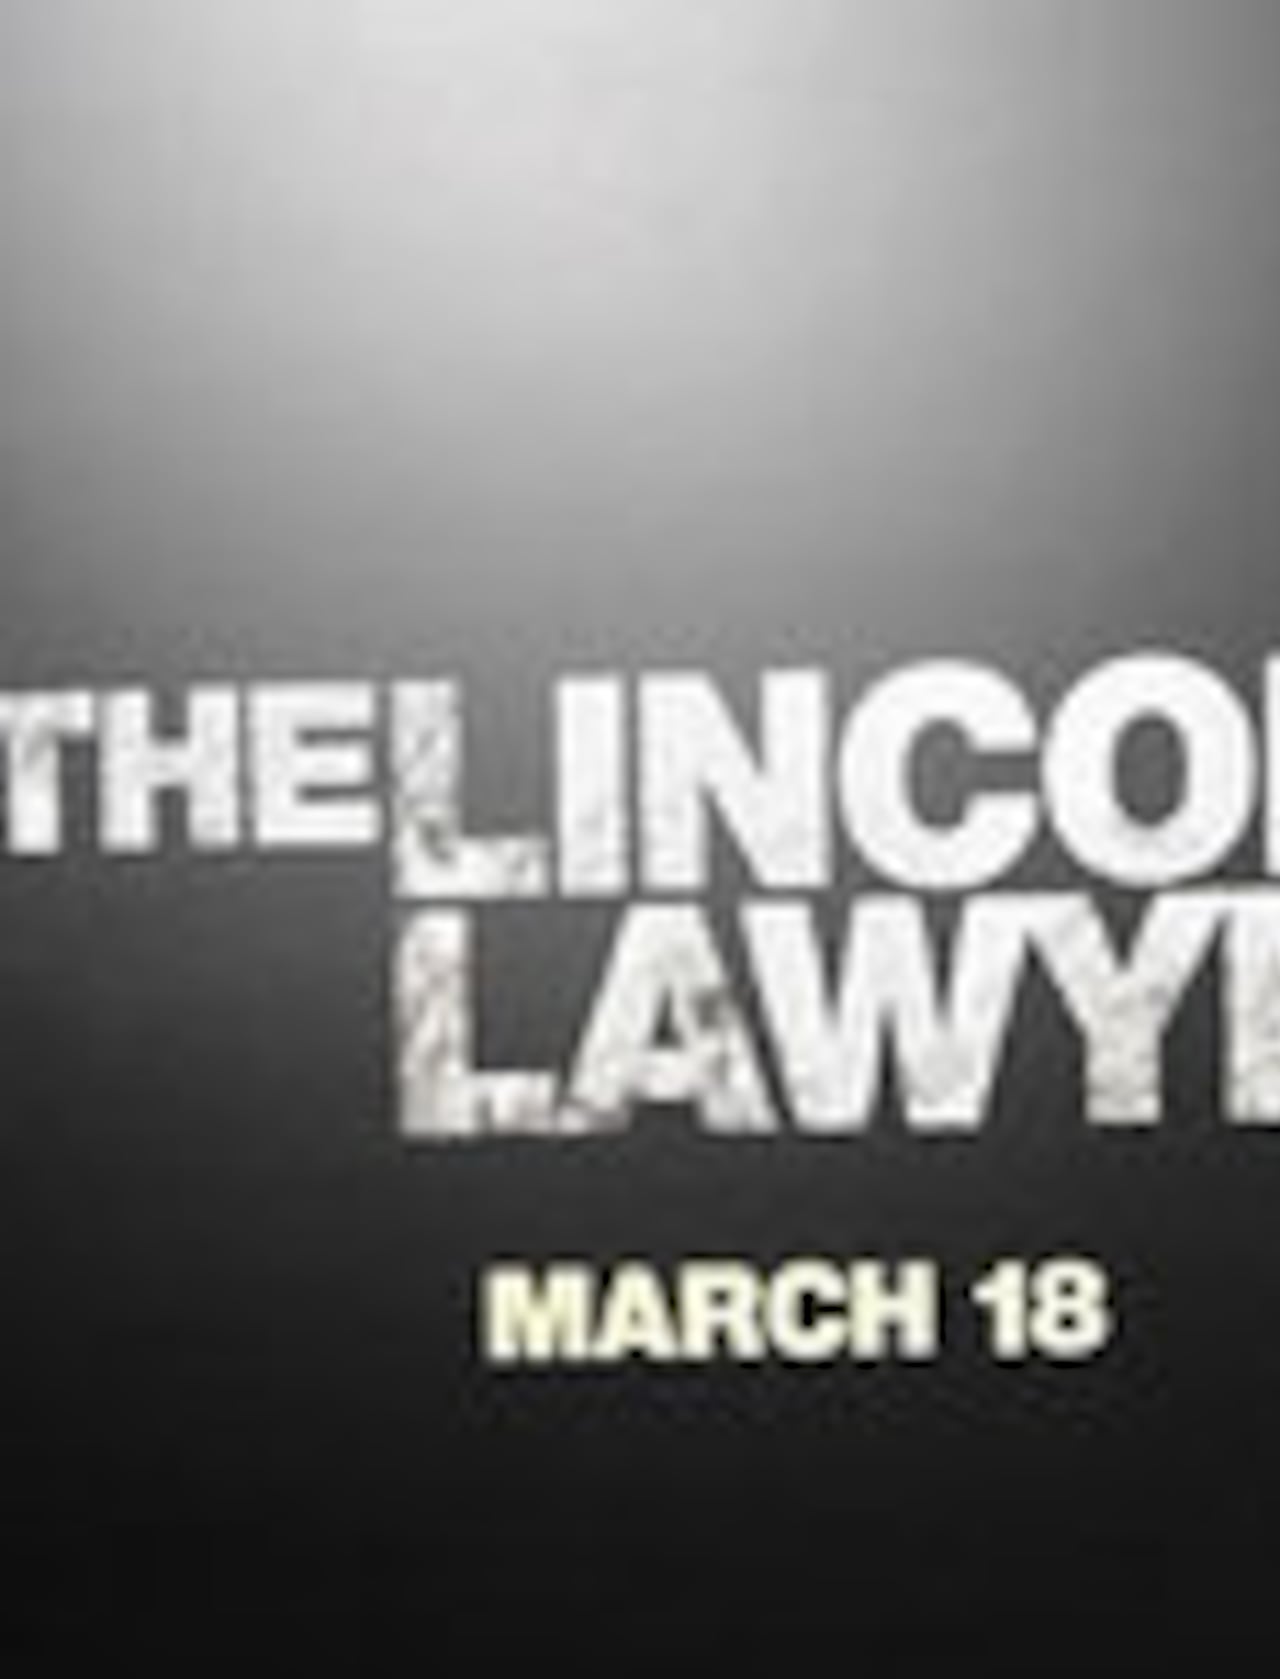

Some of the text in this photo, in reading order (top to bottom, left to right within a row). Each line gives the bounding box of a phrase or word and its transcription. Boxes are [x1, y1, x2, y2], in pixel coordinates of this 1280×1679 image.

[0, 680, 382, 854] THE
[483, 1257, 1110, 1364] MARCH 18
